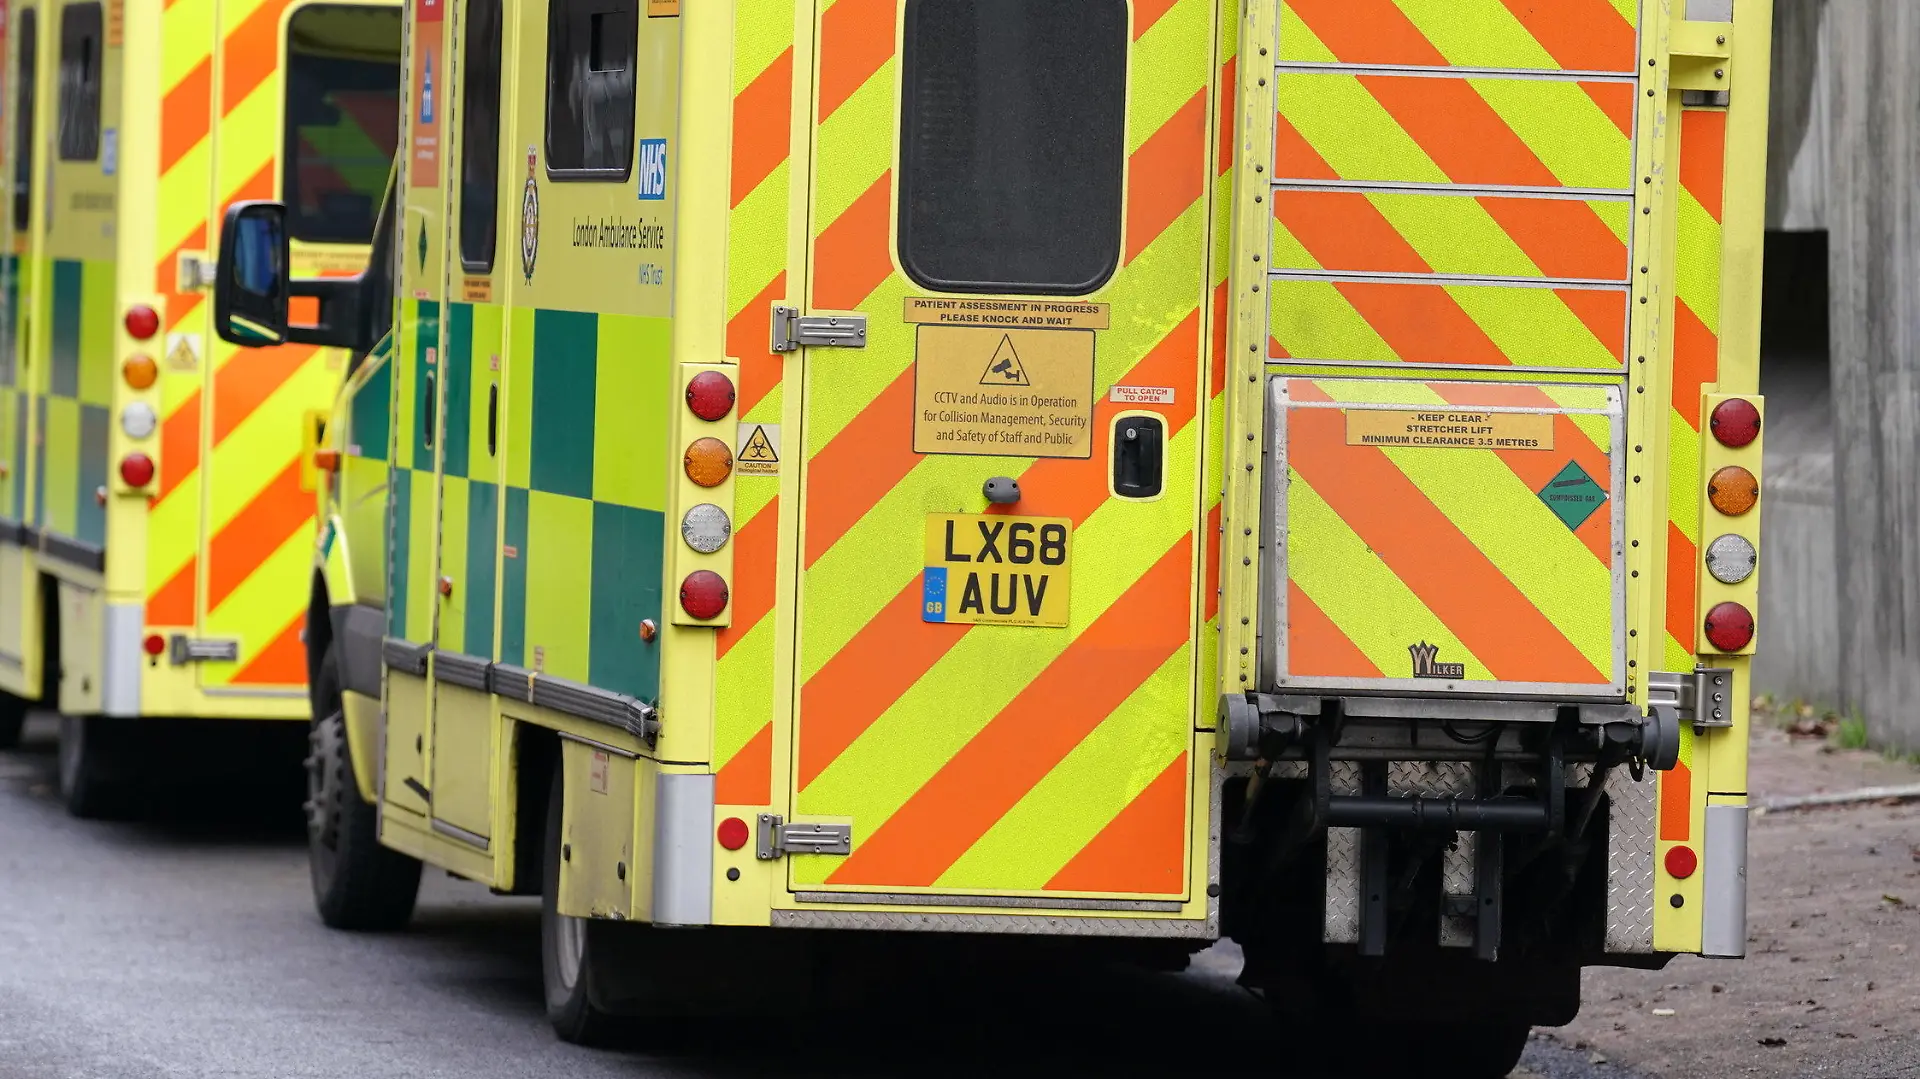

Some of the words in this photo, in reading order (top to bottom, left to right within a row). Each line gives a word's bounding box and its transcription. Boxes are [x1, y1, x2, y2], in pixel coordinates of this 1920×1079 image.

[639, 143, 666, 195] NHS
[572, 215, 597, 248] London
[598, 215, 637, 249] Ambulance
[638, 217, 664, 249] Service
[639, 263, 650, 285] NHS
[650, 263, 663, 286] Trust
[914, 300, 957, 309] PATIENT
[959, 301, 1029, 312] ASSESSMENT
[1031, 304, 1041, 312] IN
[1044, 304, 1100, 314] PROGRESS
[940, 313, 979, 322] PLEASE
[982, 315, 1018, 323] KNOCK
[1021, 316, 1044, 324] AND
[1046, 317, 1072, 325] WAIT
[934, 391, 959, 404] CCTV
[960, 393, 978, 405] and
[980, 393, 1008, 406] Audio
[1009, 394, 1017, 406] is
[1019, 395, 1029, 406] in
[1031, 395, 1077, 409] Operation
[924, 409, 937, 423] for
[939, 410, 978, 423] Collision
[980, 412, 1046, 427] Management,
[1048, 414, 1087, 430] Security
[1417, 414, 1445, 422] KEEP
[1448, 414, 1482, 423] CLEAR
[936, 429, 954, 442] and
[956, 430, 986, 444] Safety
[988, 430, 999, 443] of
[1000, 431, 1022, 444] Staff
[1024, 432, 1042, 444] and
[1044, 433, 1073, 445] Public
[1406, 425, 1468, 434] STRETCHER
[1471, 426, 1493, 434] LIFT
[1361, 435, 1410, 444] MINIMUM
[1413, 436, 1475, 446] CLEARANCE
[1478, 438, 1493, 446] 3.5
[1496, 438, 1539, 447] METRES
[945, 519, 1067, 566] LX68
[959, 572, 1049, 616] AUV
[926, 601, 943, 614] GB
[1410, 645, 1463, 675] WILKER
